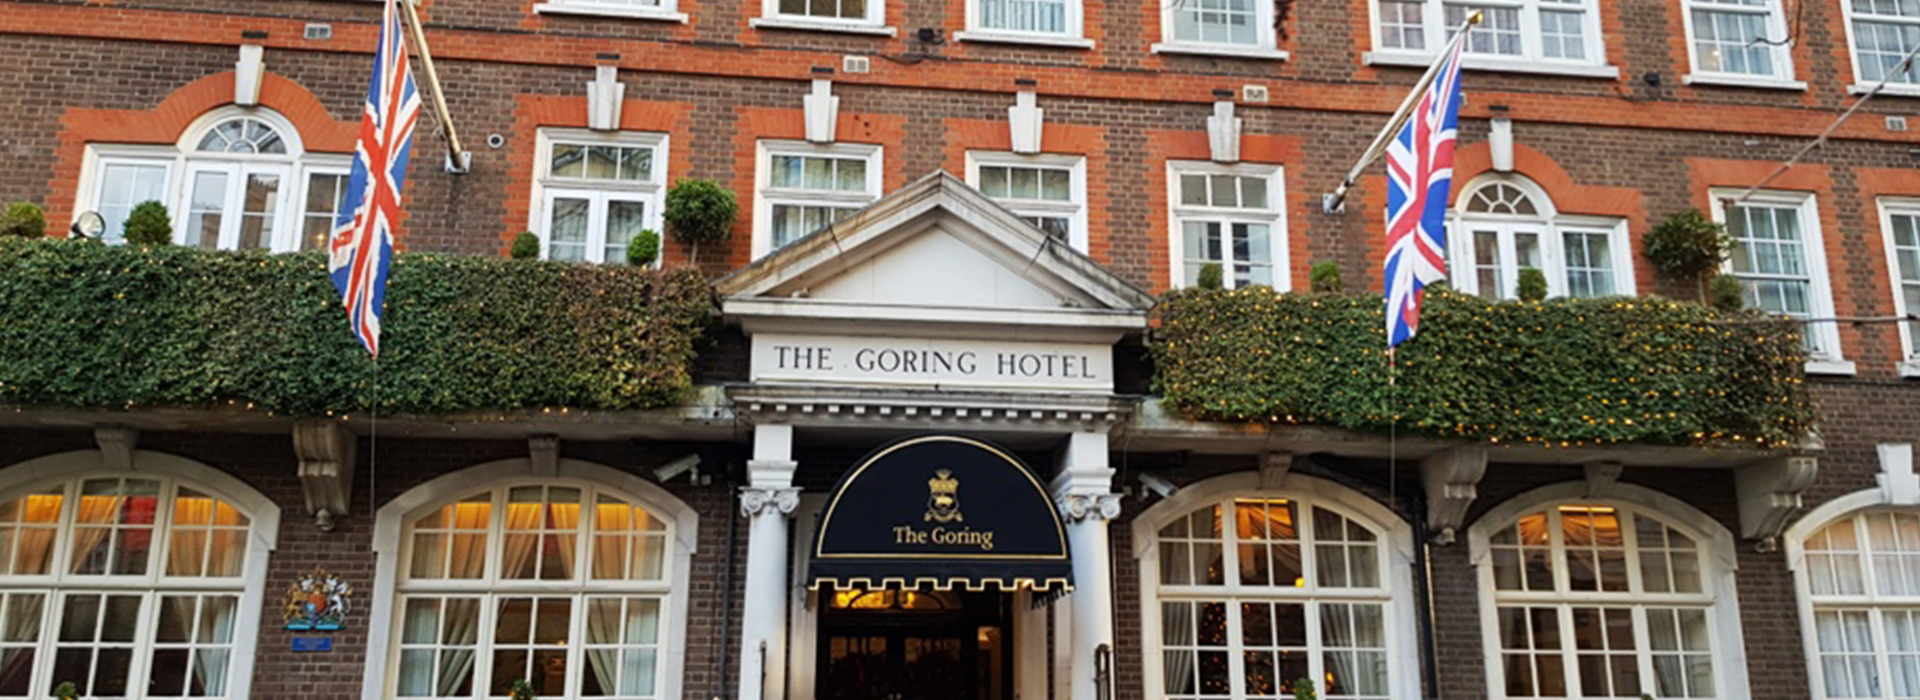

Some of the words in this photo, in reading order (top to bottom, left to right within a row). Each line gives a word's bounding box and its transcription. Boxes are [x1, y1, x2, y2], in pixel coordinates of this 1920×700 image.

[773, 346, 834, 371] THE
[855, 348, 977, 375] GORING
[997, 353, 1096, 379] HOTEL
[893, 526, 928, 544] The
[932, 526, 994, 550] Goring
